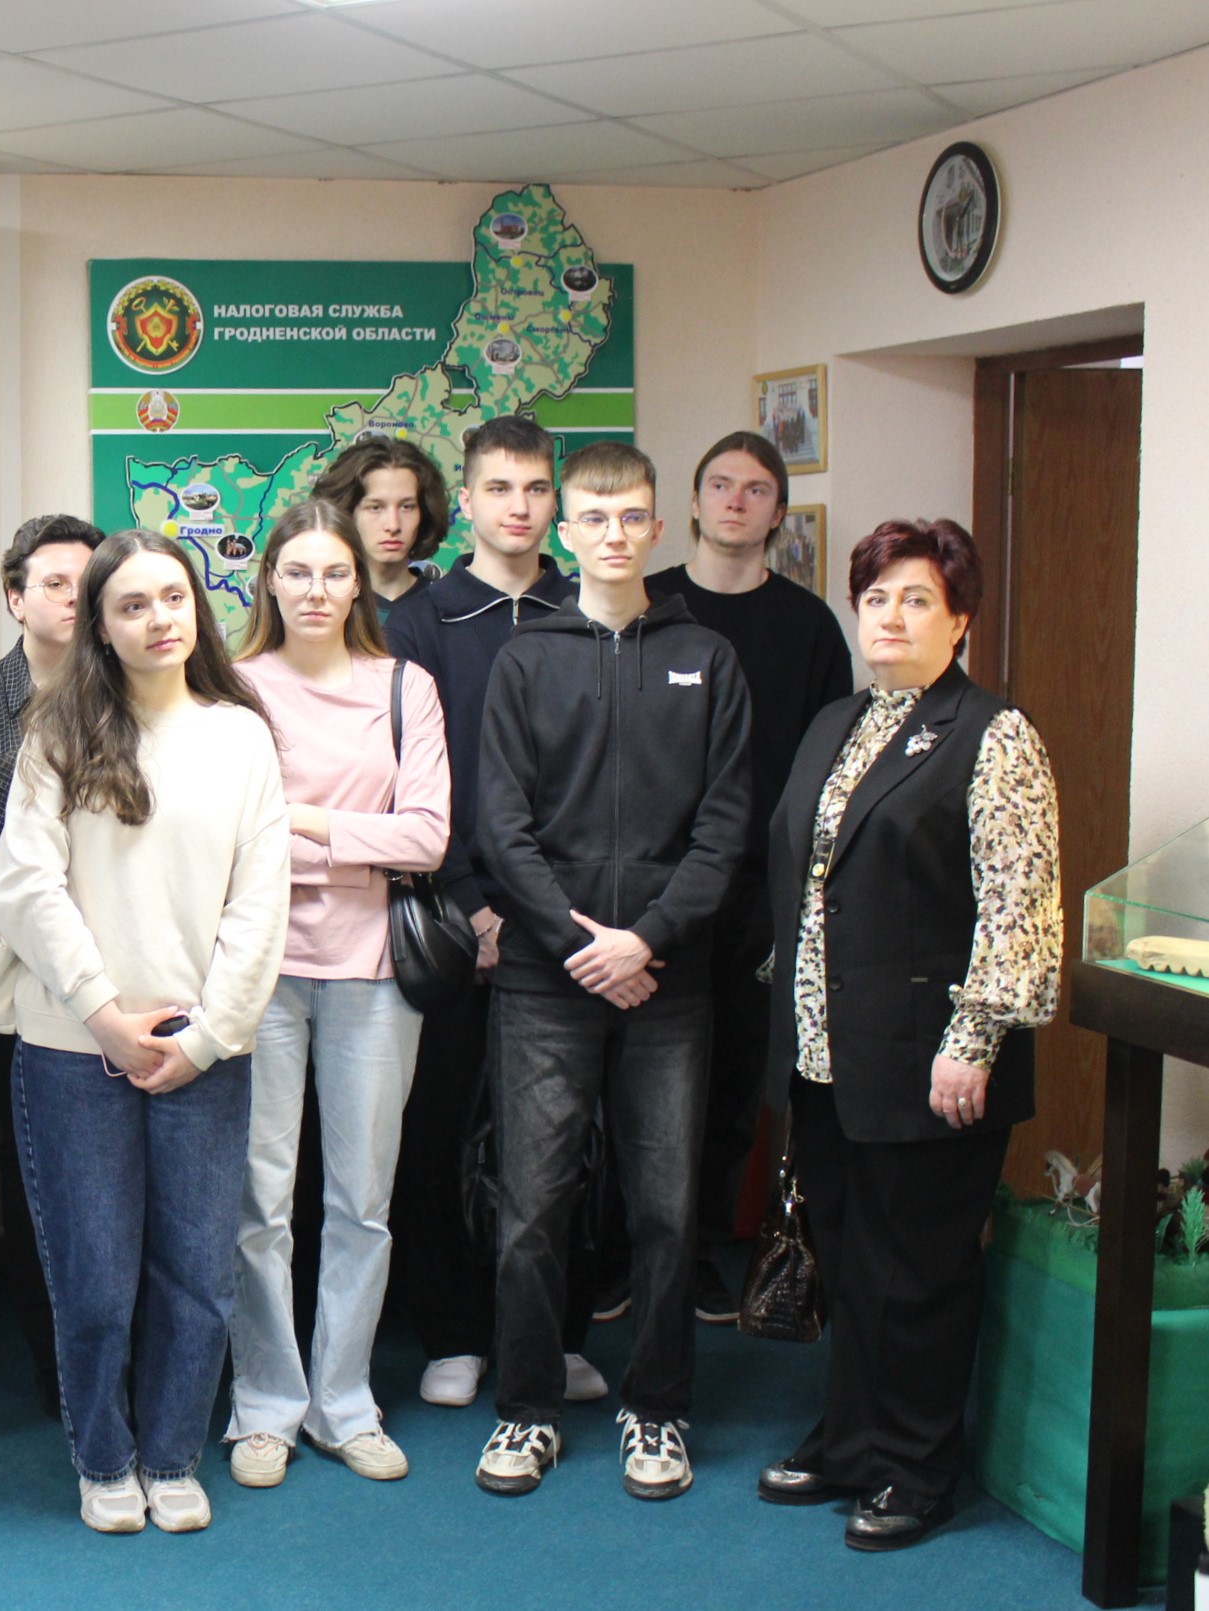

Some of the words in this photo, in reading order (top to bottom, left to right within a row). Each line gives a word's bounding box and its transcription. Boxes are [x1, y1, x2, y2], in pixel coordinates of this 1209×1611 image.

[213, 304, 324, 318] НАЛОГОВАЯ
[328, 304, 403, 318] СЛУЖБА
[213, 325, 347, 342] ГРОДНЕНСКОЙ
[352, 327, 436, 341] ОБЛАСТИ
[368, 419, 414, 429] Вороново
[180, 526, 223, 536] Гродно
